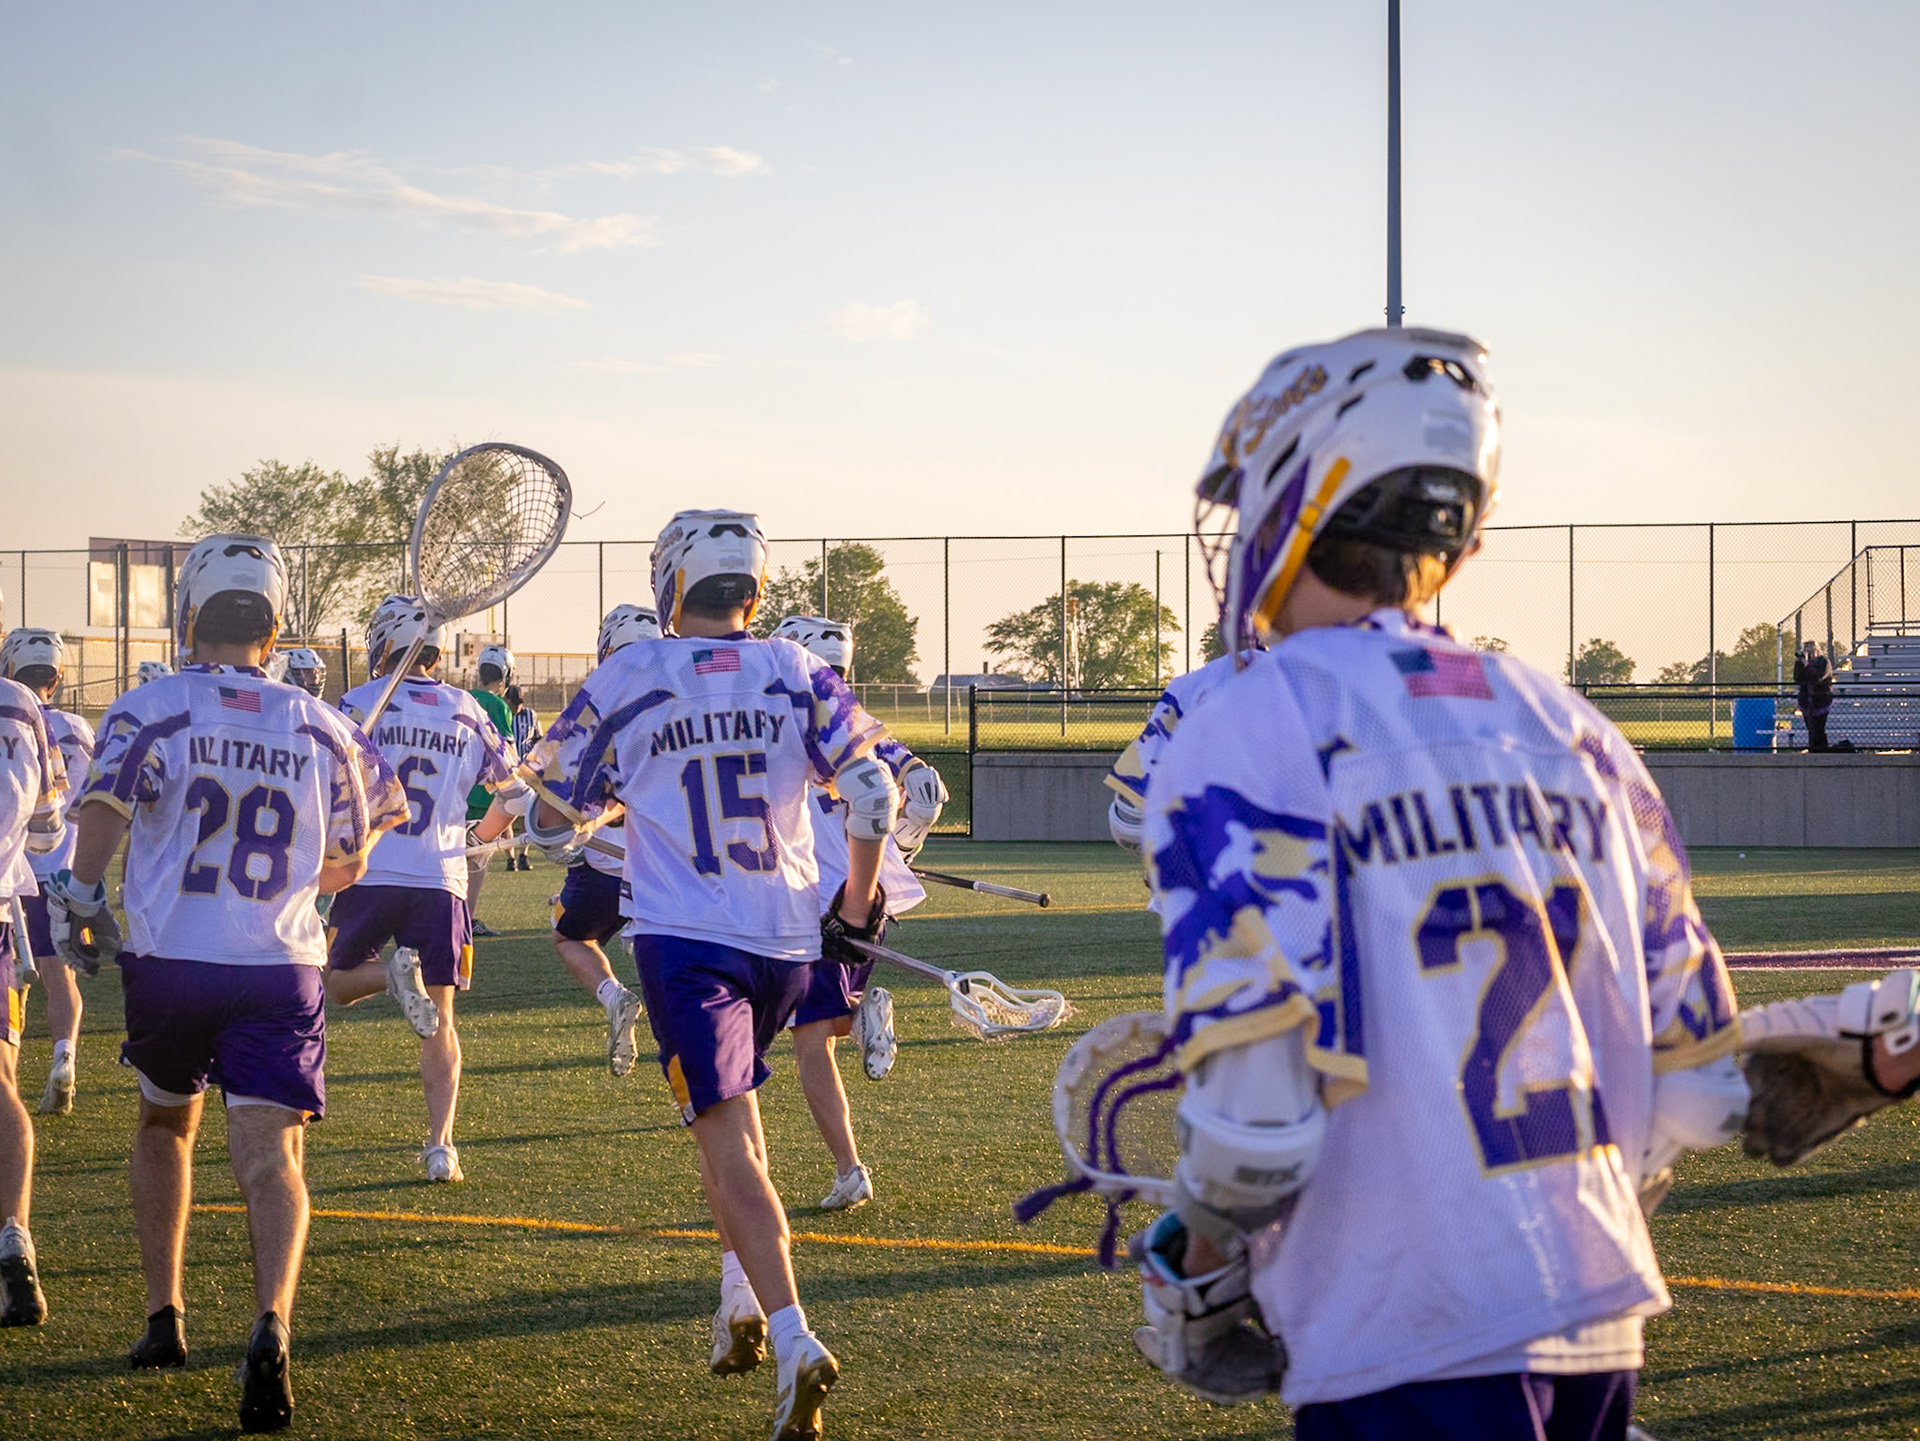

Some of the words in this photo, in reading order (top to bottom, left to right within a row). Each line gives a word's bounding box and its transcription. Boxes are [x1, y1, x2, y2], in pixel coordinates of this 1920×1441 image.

[378, 726, 467, 758] MILITARY
[178, 775, 297, 903] 28
[393, 753, 440, 837] 6
[680, 751, 781, 877] 15
[1332, 783, 1608, 872] MILITARY
